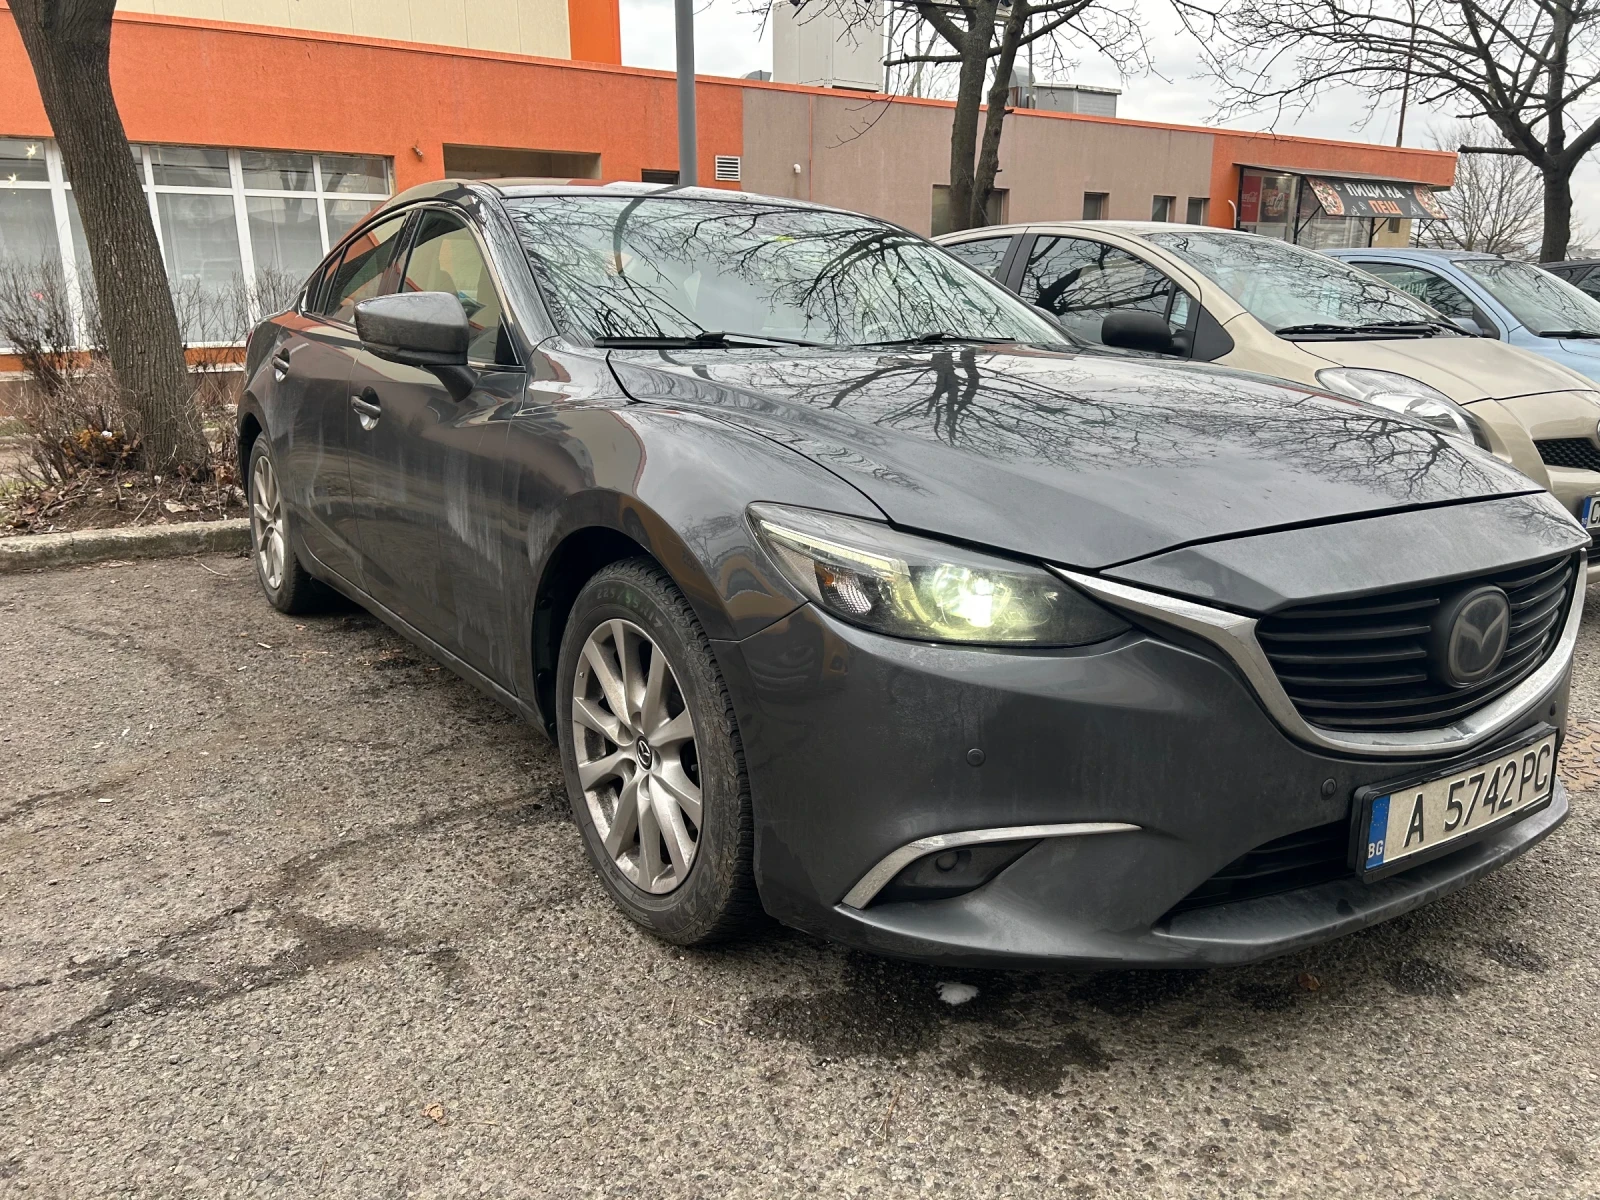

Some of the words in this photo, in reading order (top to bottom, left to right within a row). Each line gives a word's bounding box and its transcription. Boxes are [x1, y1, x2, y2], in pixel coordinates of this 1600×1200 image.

[1344, 183, 1385, 198] ПИЦИ
[1382, 185, 1406, 199] НА
[1403, 792, 1424, 848] A
[1368, 840, 1383, 858] BG
